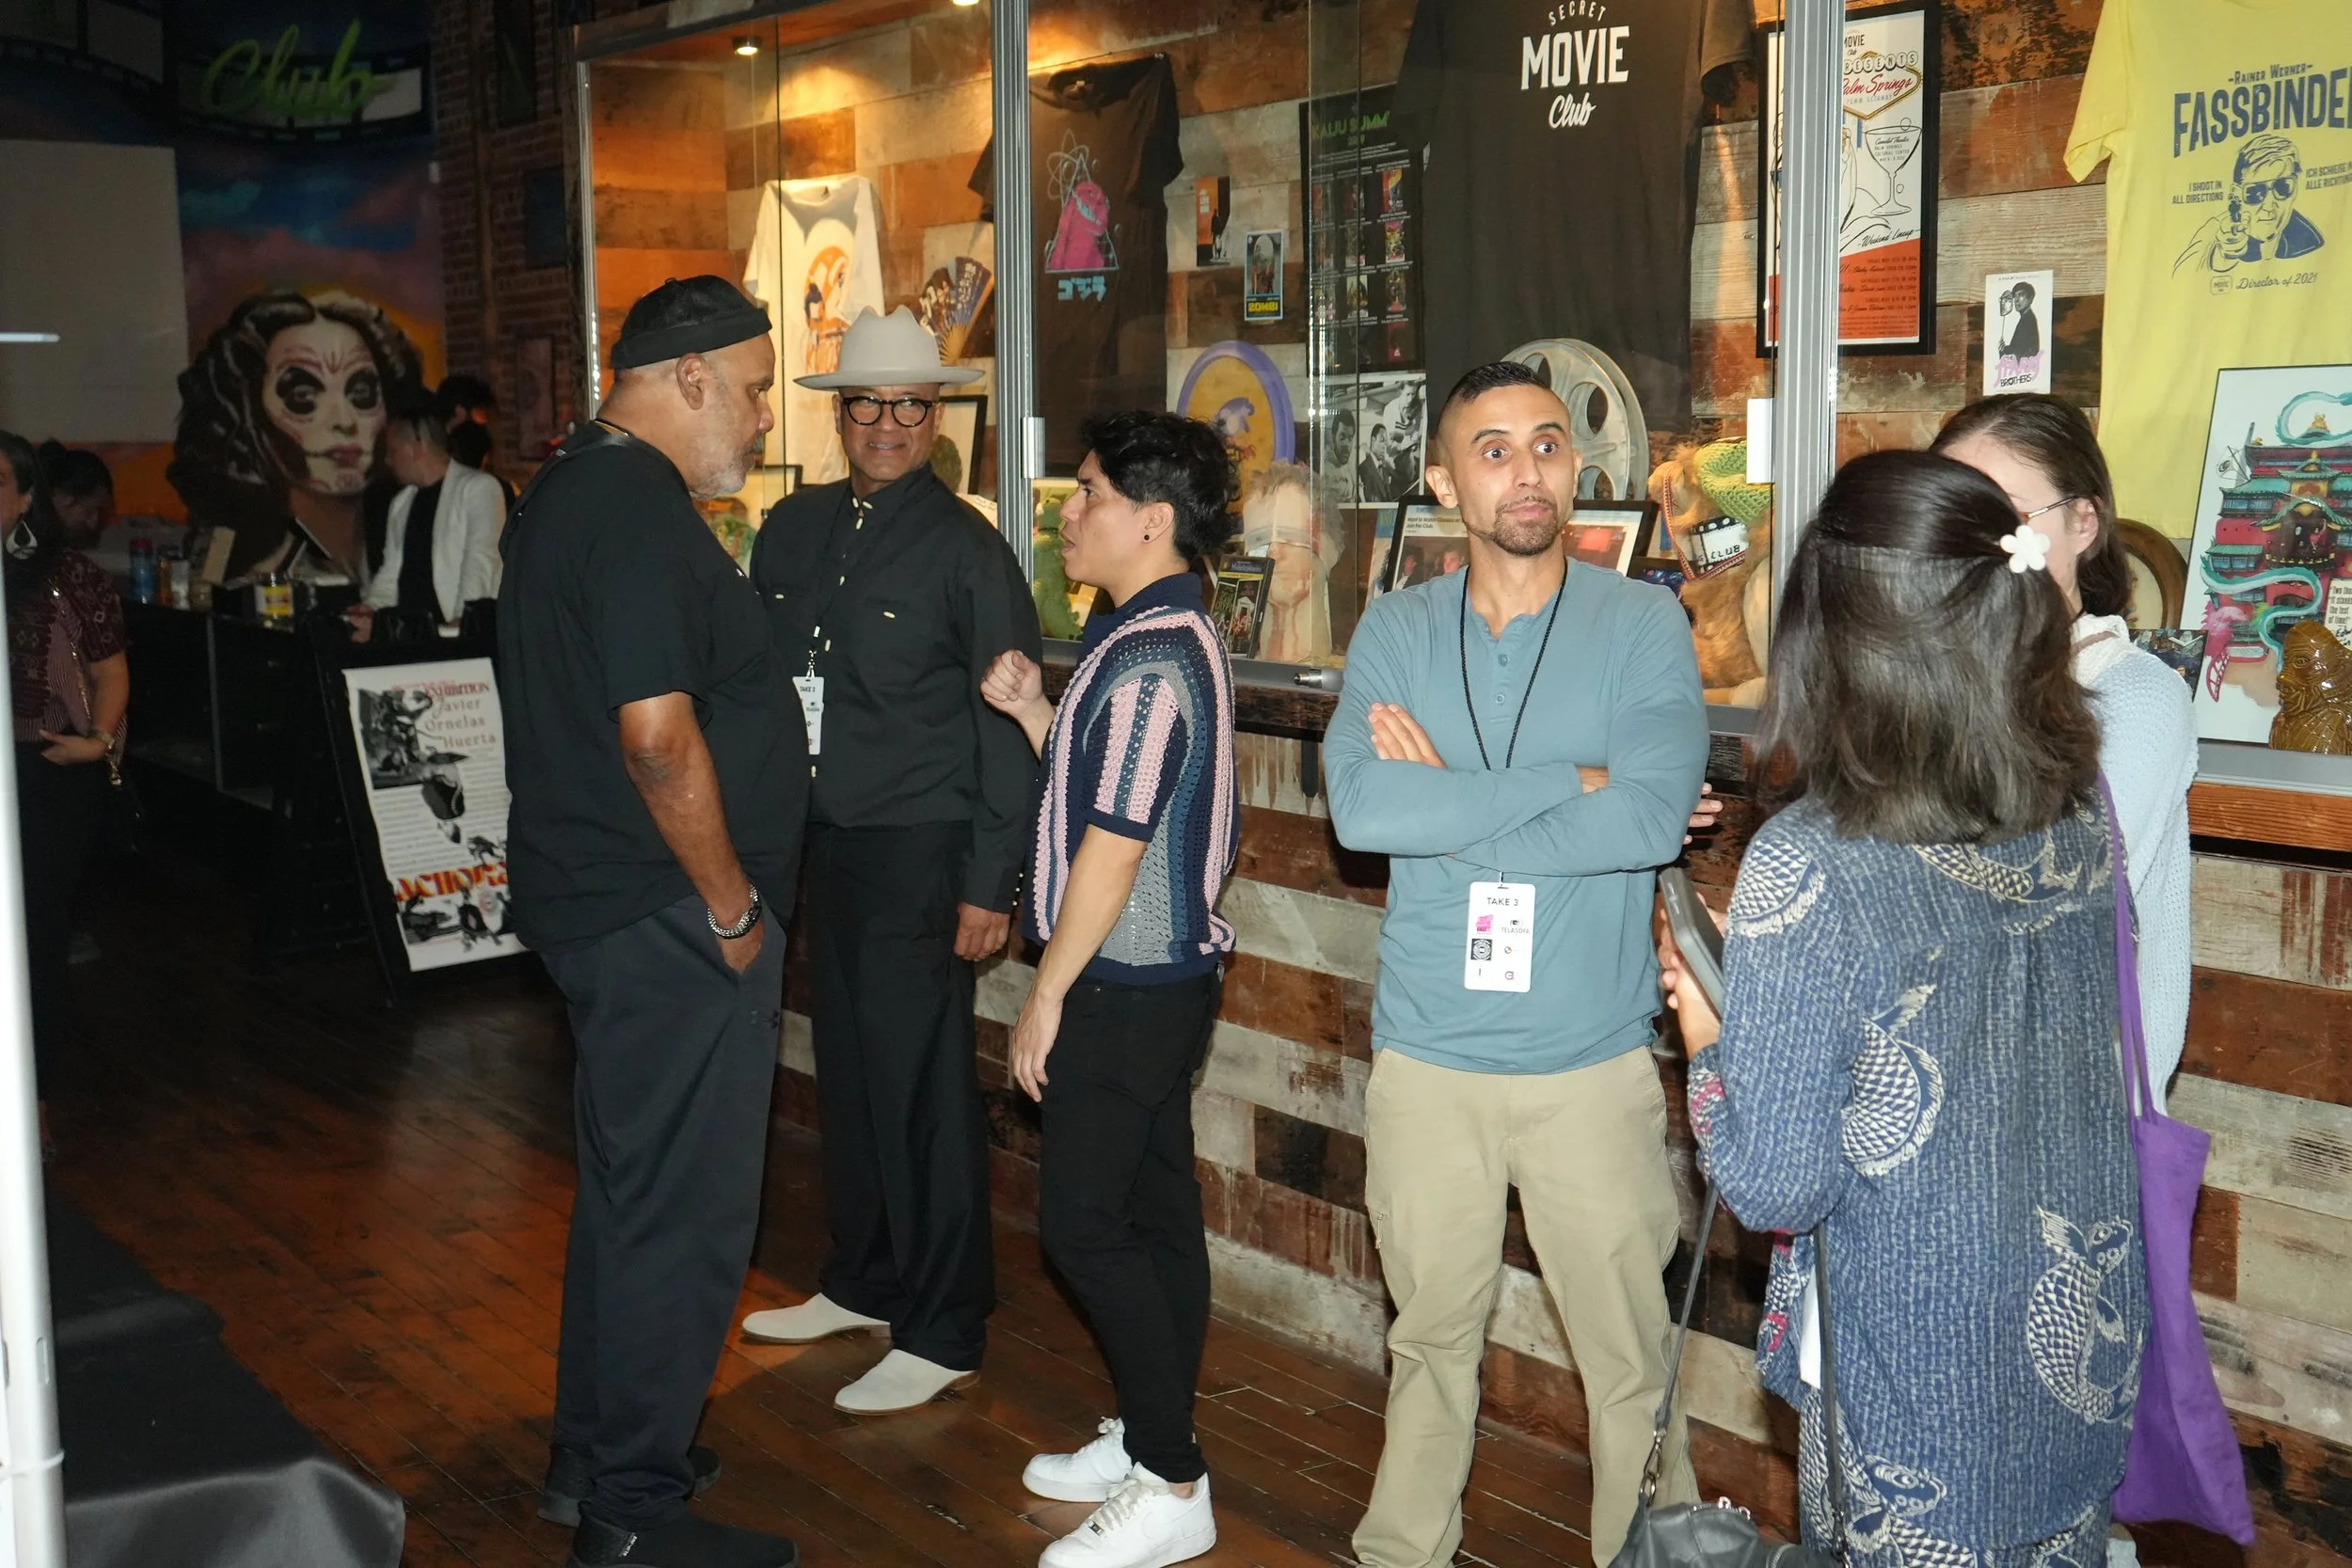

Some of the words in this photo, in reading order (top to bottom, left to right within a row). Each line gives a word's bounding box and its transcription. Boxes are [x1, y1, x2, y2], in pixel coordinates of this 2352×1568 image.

[1549, 0, 1606, 26] SECRET
[1521, 25, 1629, 90] MOVIE
[200, 17, 395, 119] Club
[1866, 73, 1913, 97] Springs
[1549, 92, 1597, 129] Club
[2173, 65, 2352, 158] FASSBINDE
[2193, 181, 2214, 192] SHOOT
[2215, 181, 2222, 189] IN
[2305, 179, 2322, 190] ALLE
[2172, 195, 2184, 204] ALL
[2186, 192, 2223, 203] DIRECTIONS
[2235, 276, 2280, 289] Director
[2282, 276, 2292, 287] of
[2000, 373, 2032, 388] BROTHERS
[1711, 545, 1740, 559] CLUB
[432, 697, 481, 719] Javier
[424, 715, 485, 732] Ornelas
[442, 733, 496, 749] Huerta
[1487, 897, 1510, 907] TAKE
[1514, 898, 1519, 907] 3
